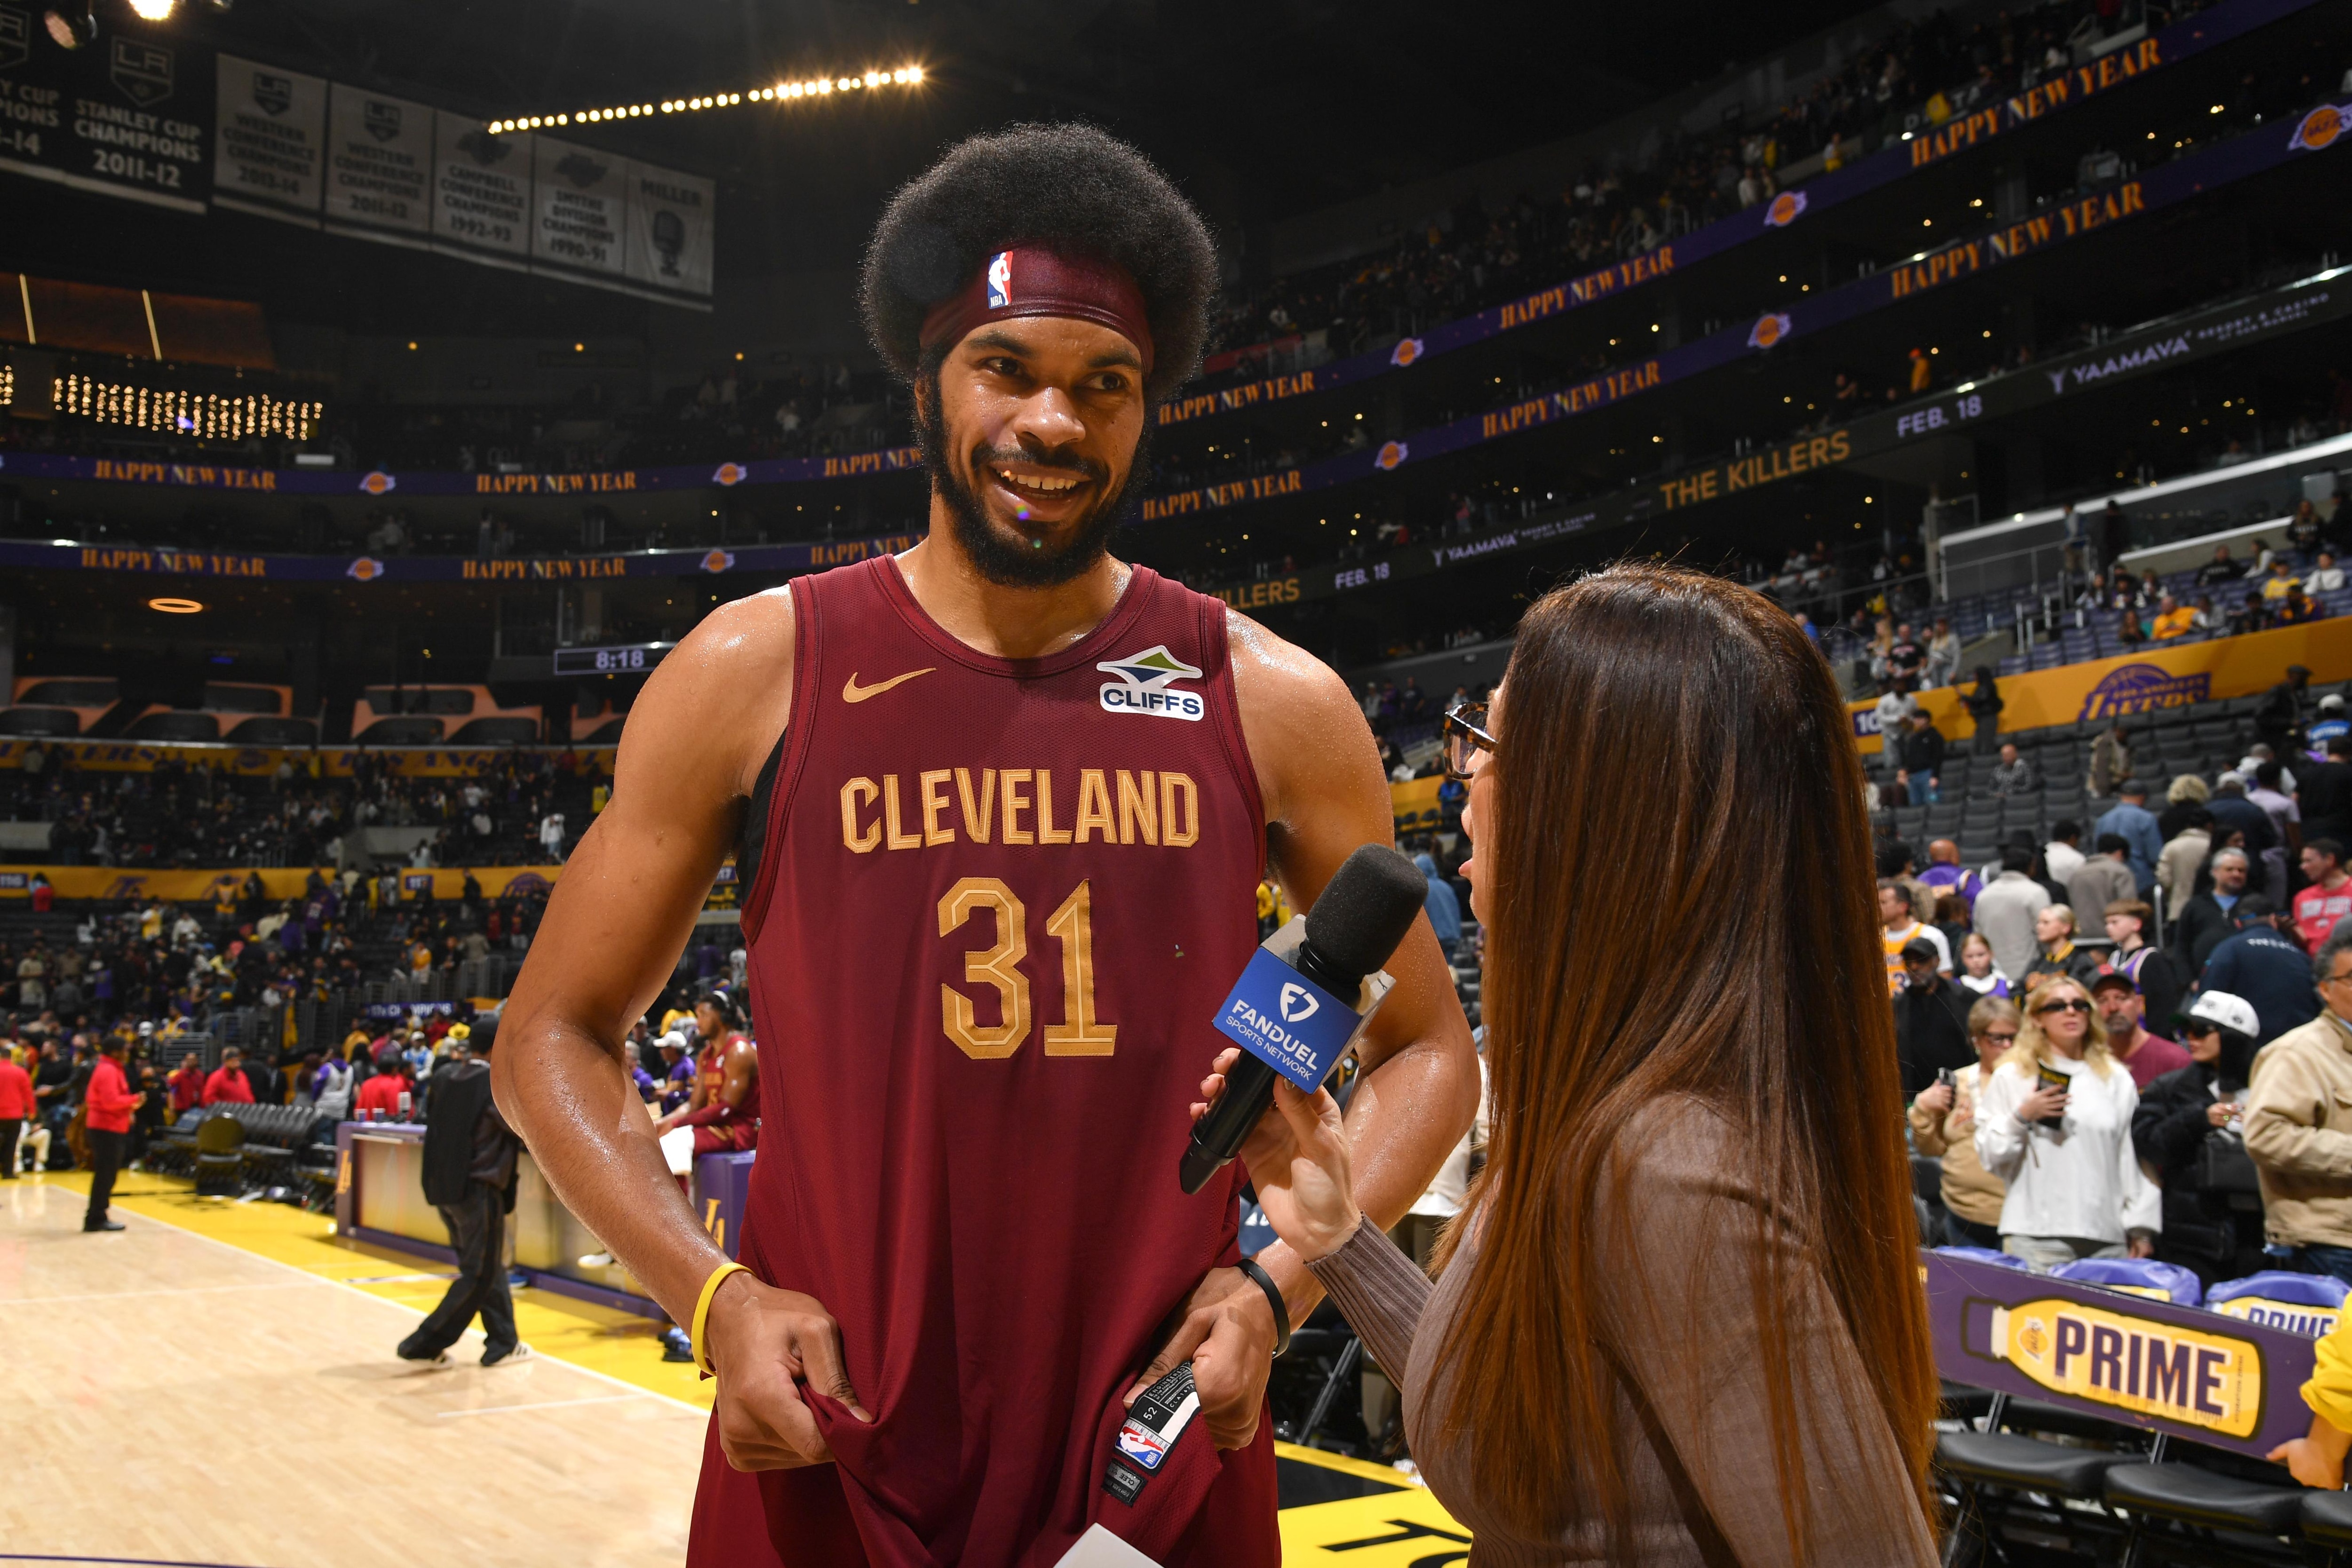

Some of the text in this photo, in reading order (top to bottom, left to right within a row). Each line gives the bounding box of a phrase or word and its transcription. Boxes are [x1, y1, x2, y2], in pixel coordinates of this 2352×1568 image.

[19, 85, 60, 105] CUP
[1911, 38, 2161, 167] HAPPY NEW YEAR
[76, 97, 201, 141] STANLEY CUP
[236, 113, 306, 142] WESTERN
[74, 118, 201, 163] CHAMPIONS
[223, 127, 315, 161] CONFERENCE
[347, 142, 414, 166] WESTERN
[93, 148, 181, 188] 2011-12
[227, 143, 310, 176] CHAMPIONS
[335, 155, 424, 184] CONFERENCE
[339, 172, 420, 199] CHAMPIONS
[449, 165, 516, 191] CAMPBELL
[441, 178, 524, 208] CONFERENCE
[642, 179, 701, 207] MILLER
[444, 195, 520, 223] CHAMPIONS
[553, 205, 607, 227] DIVISION
[450, 215, 512, 242] 1992-93
[543, 217, 614, 244] CHAMPIONS
[1891, 181, 2145, 298] HAPPY NEW YEAR
[550, 238, 606, 261] 1990-91
[990, 294, 1003, 307] NBA
[1500, 246, 1674, 328] HAPPY NEW YEAR
[1160, 371, 1315, 425] HAPPY NEW YEAR
[1483, 360, 1661, 438] HAPPY NEW YEAR
[1897, 395, 1982, 438] FEB. 18
[95, 460, 277, 490] HAPPY NEW YEAR
[825, 454, 883, 477] HAPPY
[1659, 430, 1850, 510] THE KILLERS
[477, 471, 636, 493] HAPPY NEW YEAR
[1143, 470, 1301, 521] HAPPY NEW YEAR
[81, 549, 265, 577] HAPPY NEW YEAR
[811, 542, 868, 565] HAPPY
[463, 558, 626, 579] HAPPY NEW YEAR
[1335, 562, 1390, 590] FEB. 18
[596, 649, 644, 670] 8:18
[1104, 689, 1200, 715] CLIFFS
[840, 767, 1200, 853] CLEVELAND
[938, 877, 1118, 1059] 31
[1226, 1016, 1313, 1081] SPORTS NETWORK
[1232, 999, 1318, 1071] FANDUEL
[2055, 1315, 2227, 1418] PRIME
[1149, 1368, 1185, 1396] ENGINEERED
[1143, 1407, 1158, 1420] 52
[1145, 1451, 1158, 1465] NBA
